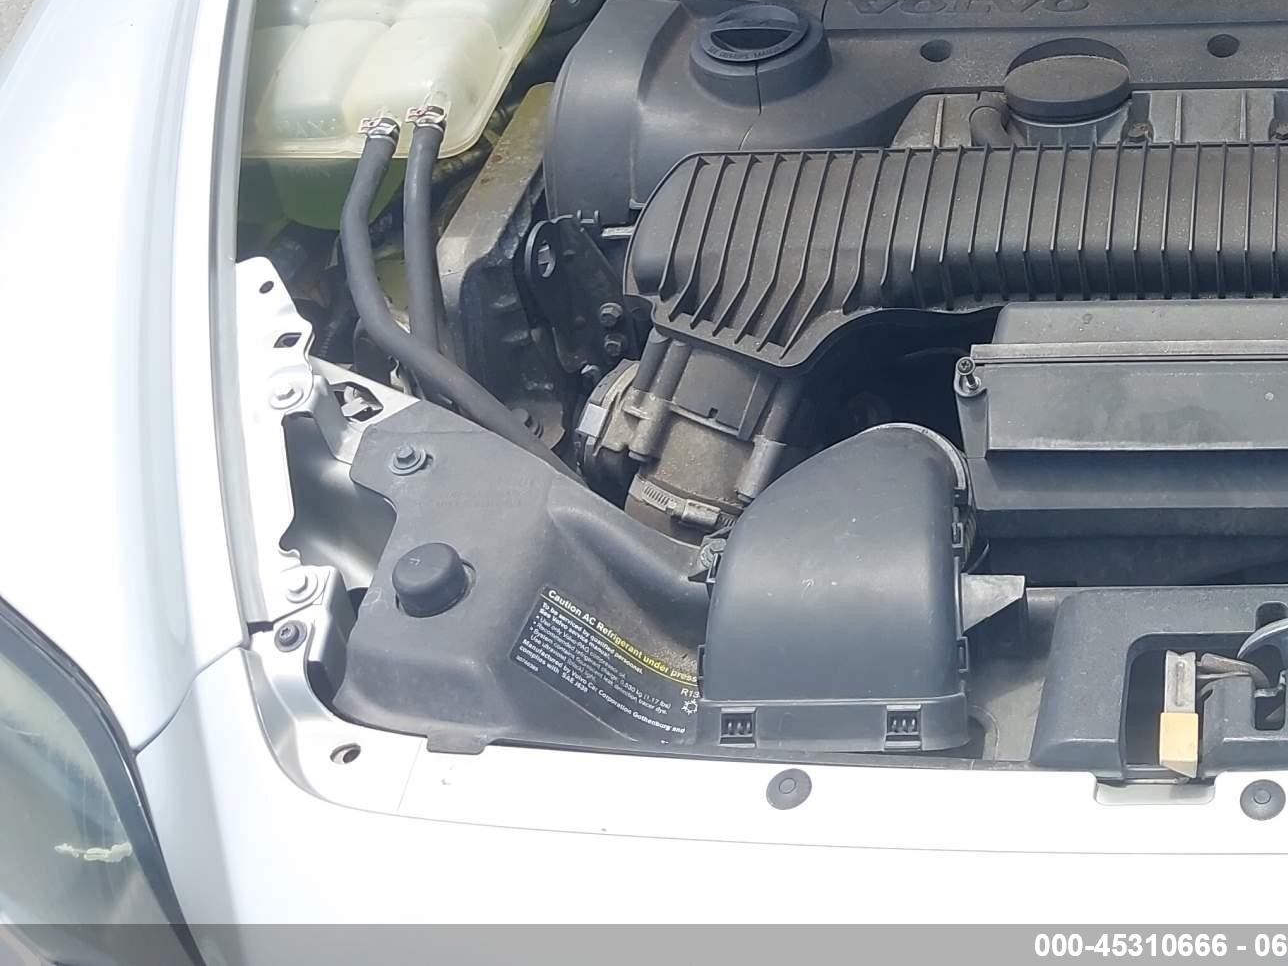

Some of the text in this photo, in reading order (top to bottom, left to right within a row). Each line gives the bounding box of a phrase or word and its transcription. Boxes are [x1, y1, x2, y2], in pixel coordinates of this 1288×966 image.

[533, 629, 554, 645] System
[536, 623, 575, 651] Recommended
[538, 608, 551, 619] See
[551, 616, 569, 630] Volvo
[568, 628, 589, 643] service
[542, 602, 550, 610] To
[550, 607, 559, 616] be
[558, 613, 583, 632] serviced
[582, 629, 590, 638] by
[589, 635, 615, 654] qualified
[547, 589, 582, 616] Caution
[582, 612, 596, 626] AC
[596, 622, 644, 659] Refrigerant
[642, 655, 670, 673] under
[519, 645, 546, 665] complies
[546, 662, 560, 674] with
[561, 672, 575, 684] SAE
[522, 639, 687, 734] Manufactured by Volvo Car Corporation Gothenburg and
